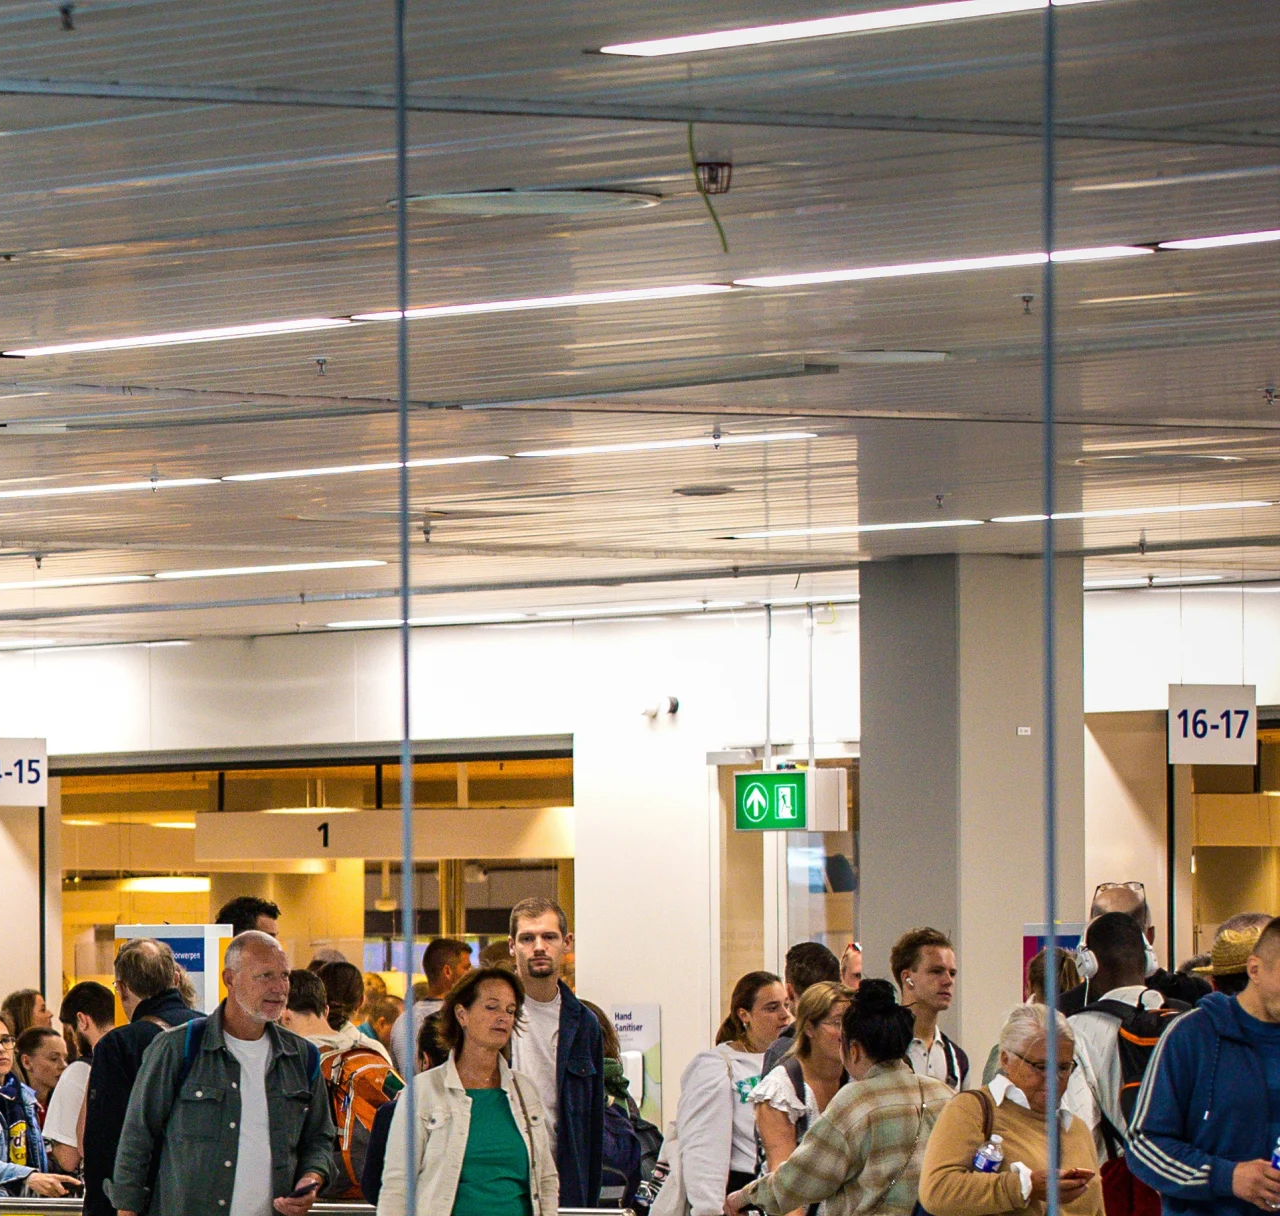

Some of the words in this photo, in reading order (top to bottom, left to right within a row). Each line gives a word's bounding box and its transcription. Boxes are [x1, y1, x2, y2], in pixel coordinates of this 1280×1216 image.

[1177, 708, 1249, 739] 16-17
[317, 822, 329, 847] 1
[614, 1012, 632, 1021] Hand
[615, 1023, 643, 1032] Sanitiser
